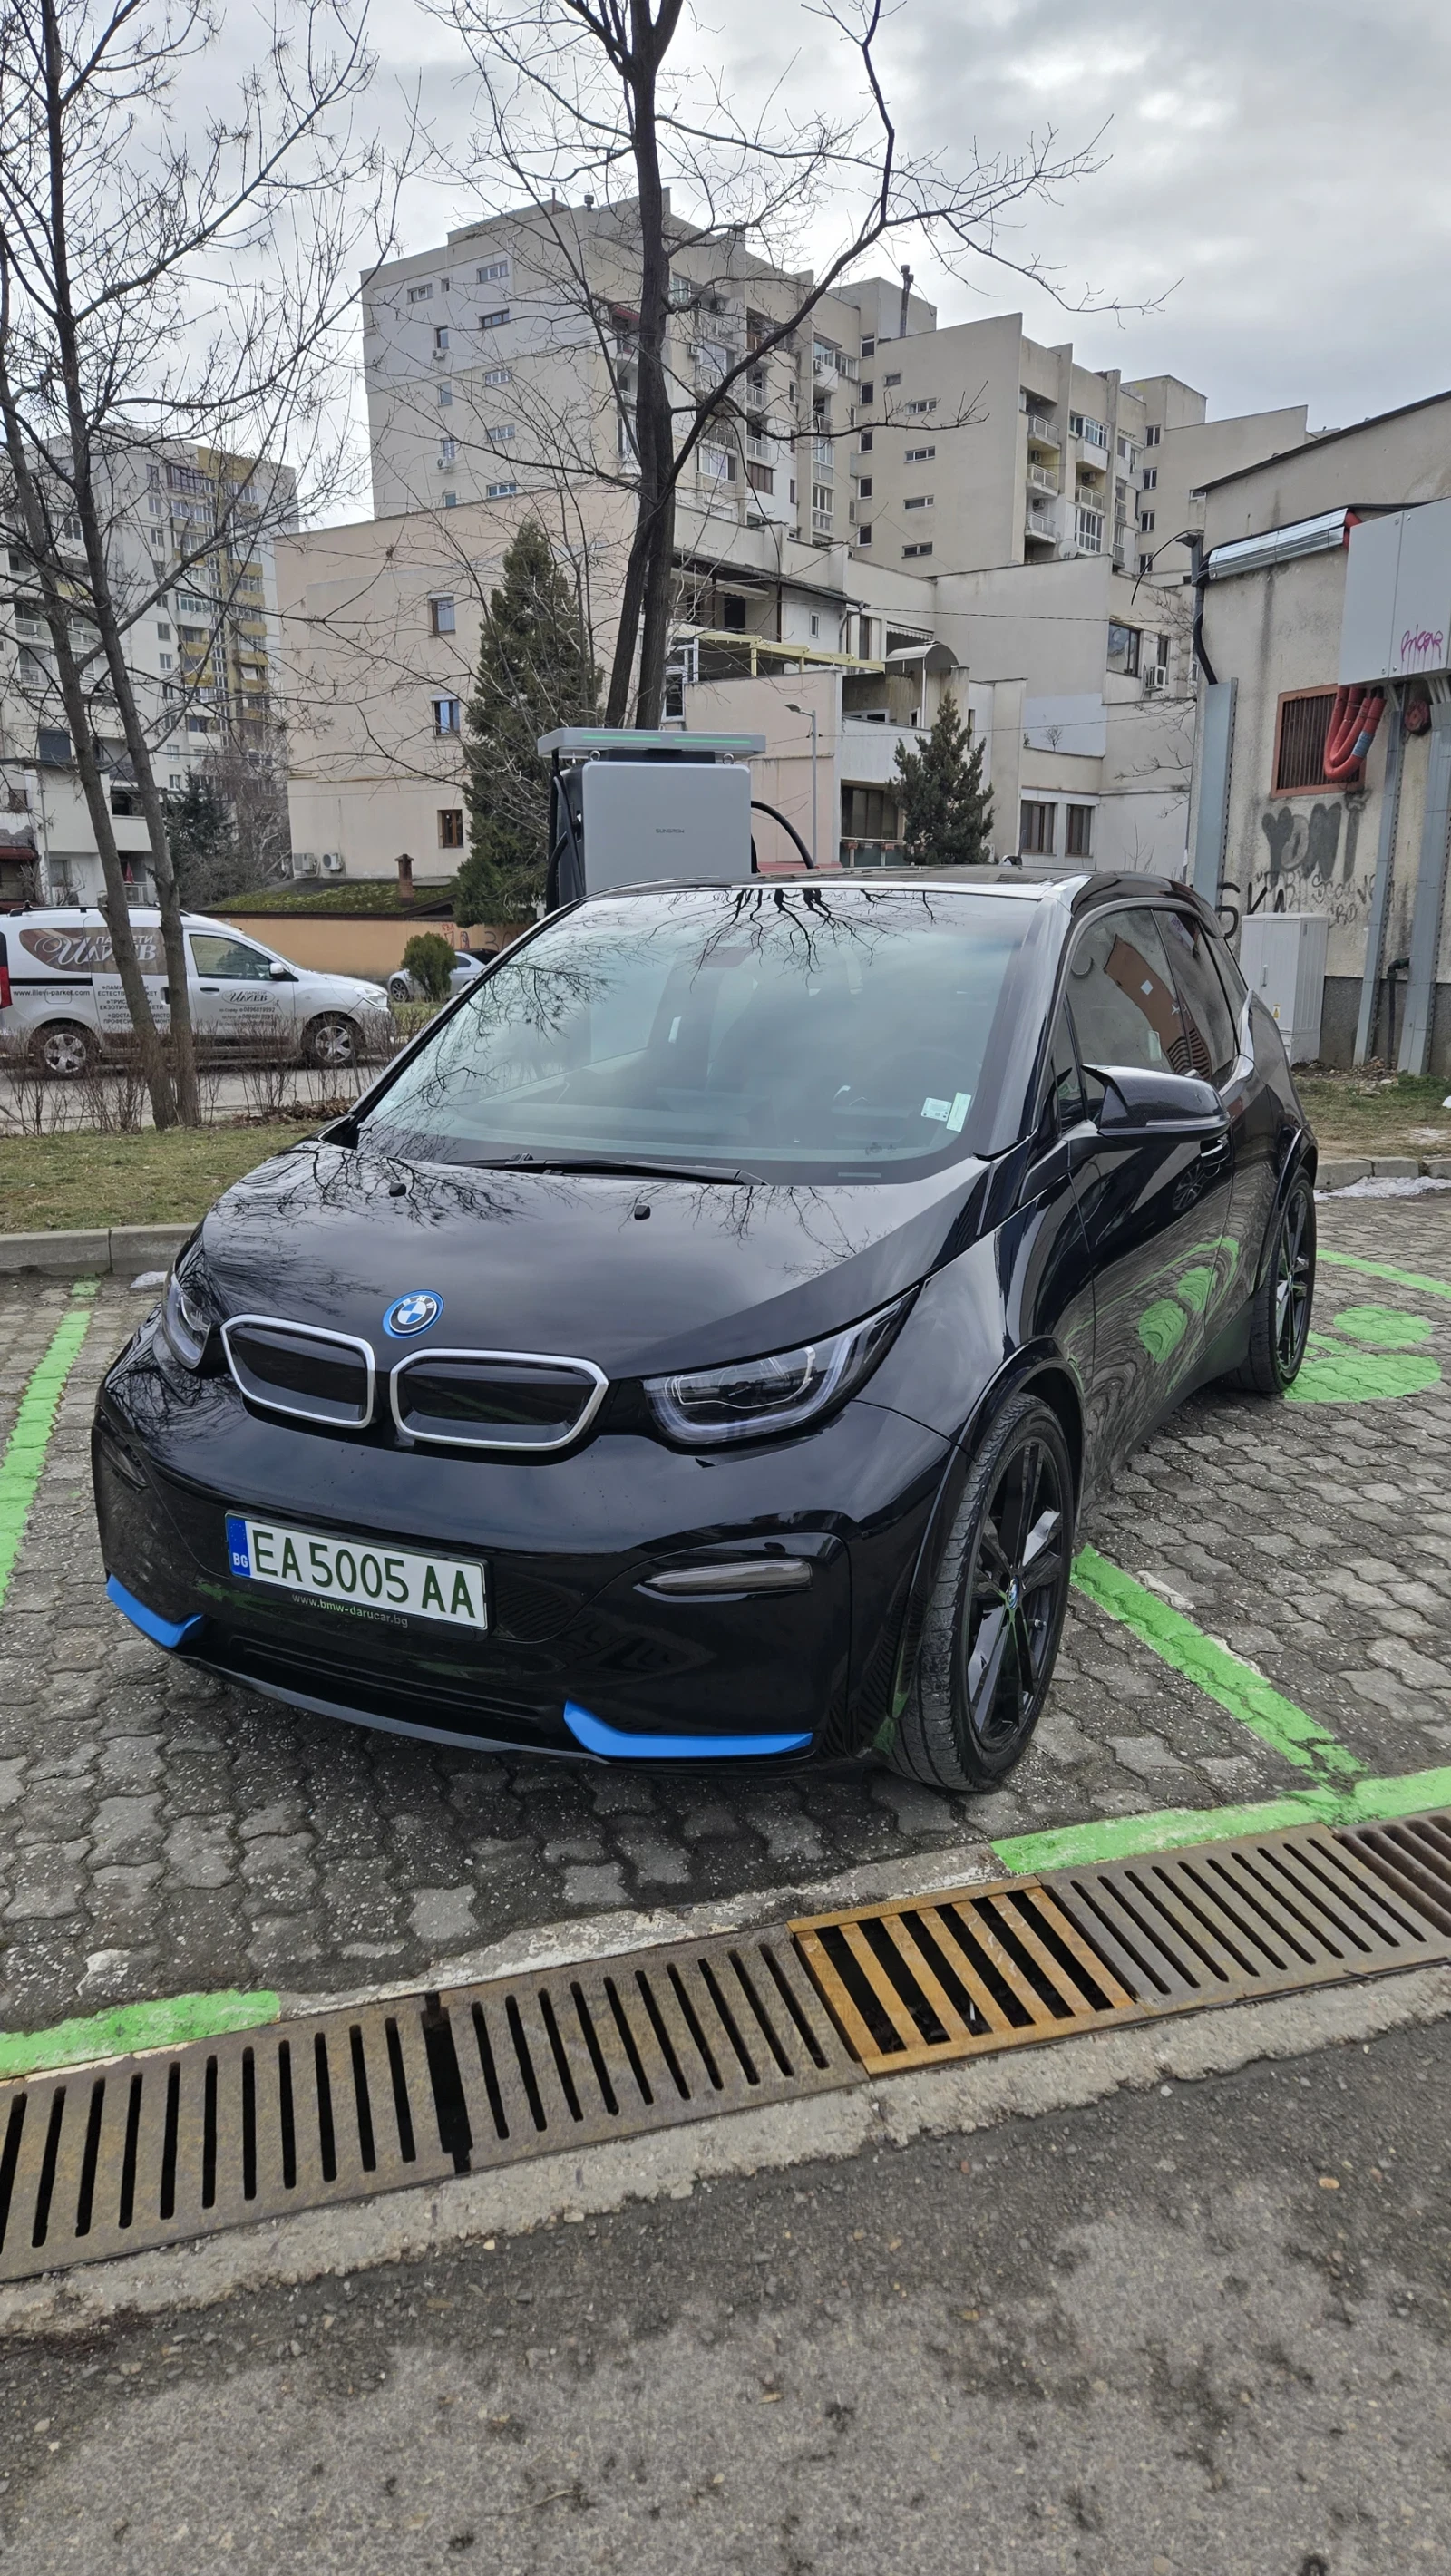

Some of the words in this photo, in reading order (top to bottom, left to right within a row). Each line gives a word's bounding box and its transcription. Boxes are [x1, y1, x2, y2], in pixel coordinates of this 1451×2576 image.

[96, 935, 153, 944] ПАЕТИ
[402, 1294, 436, 1309] BMW
[232, 1551, 249, 1568] BG
[422, 1564, 476, 1619] AA
[291, 1593, 408, 1628] www.bmw-darucar.bg
